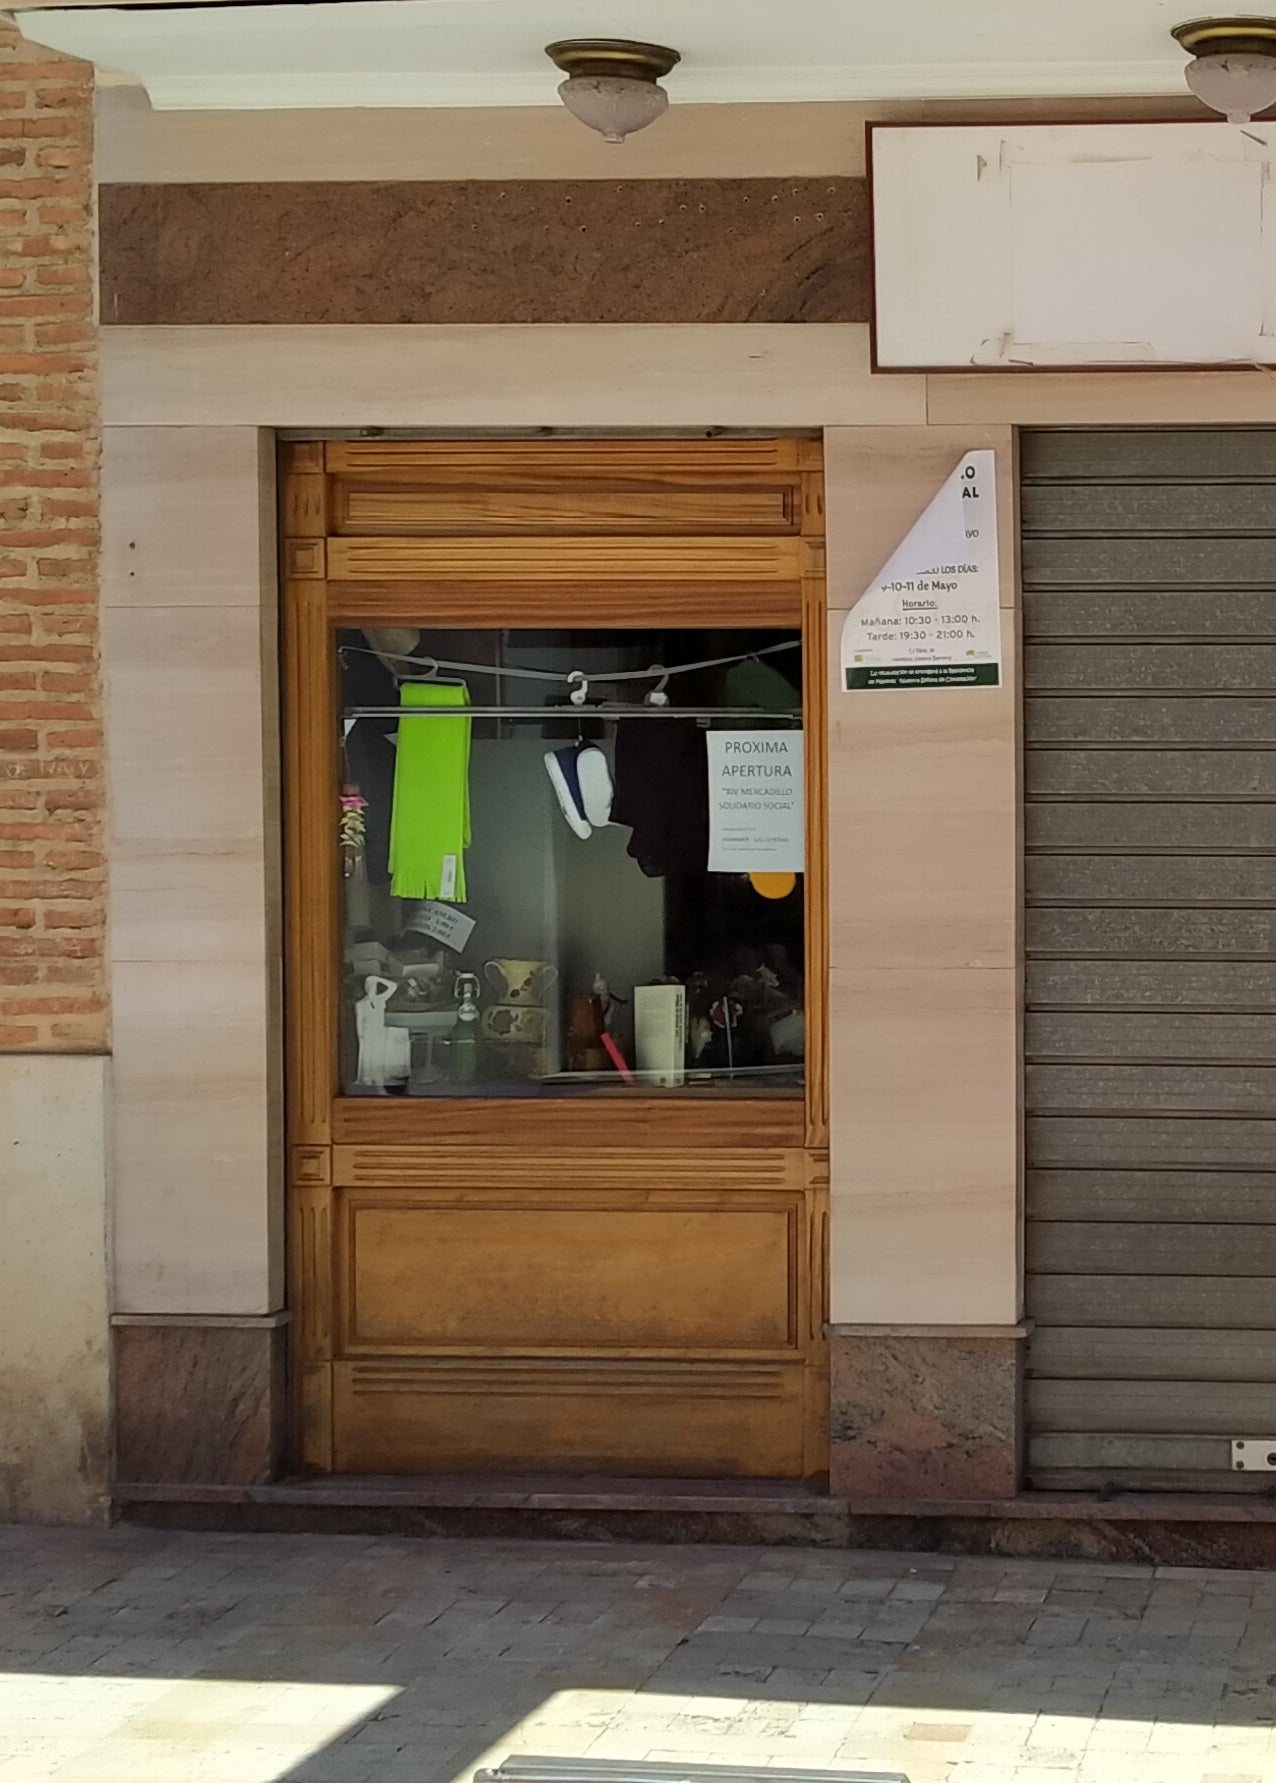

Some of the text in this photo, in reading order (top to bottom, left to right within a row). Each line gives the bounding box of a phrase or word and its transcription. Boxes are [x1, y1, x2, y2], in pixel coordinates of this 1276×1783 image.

[958, 564, 978, 573] DÍAS:
[917, 581, 929, 590] de
[932, 581, 957, 593] Mayo
[902, 599, 937, 610] Horario:
[861, 617, 901, 626] Mañana:
[904, 616, 931, 625] 10:30
[941, 615, 968, 624] 13:00
[971, 615, 980, 623] h.
[867, 632, 897, 641] Tarde:
[900, 631, 926, 640] 19:30
[936, 630, 963, 639] 21:00
[966, 630, 974, 638] h.
[725, 742, 788, 753] PROXIMA
[722, 765, 792, 777] APERTURA
